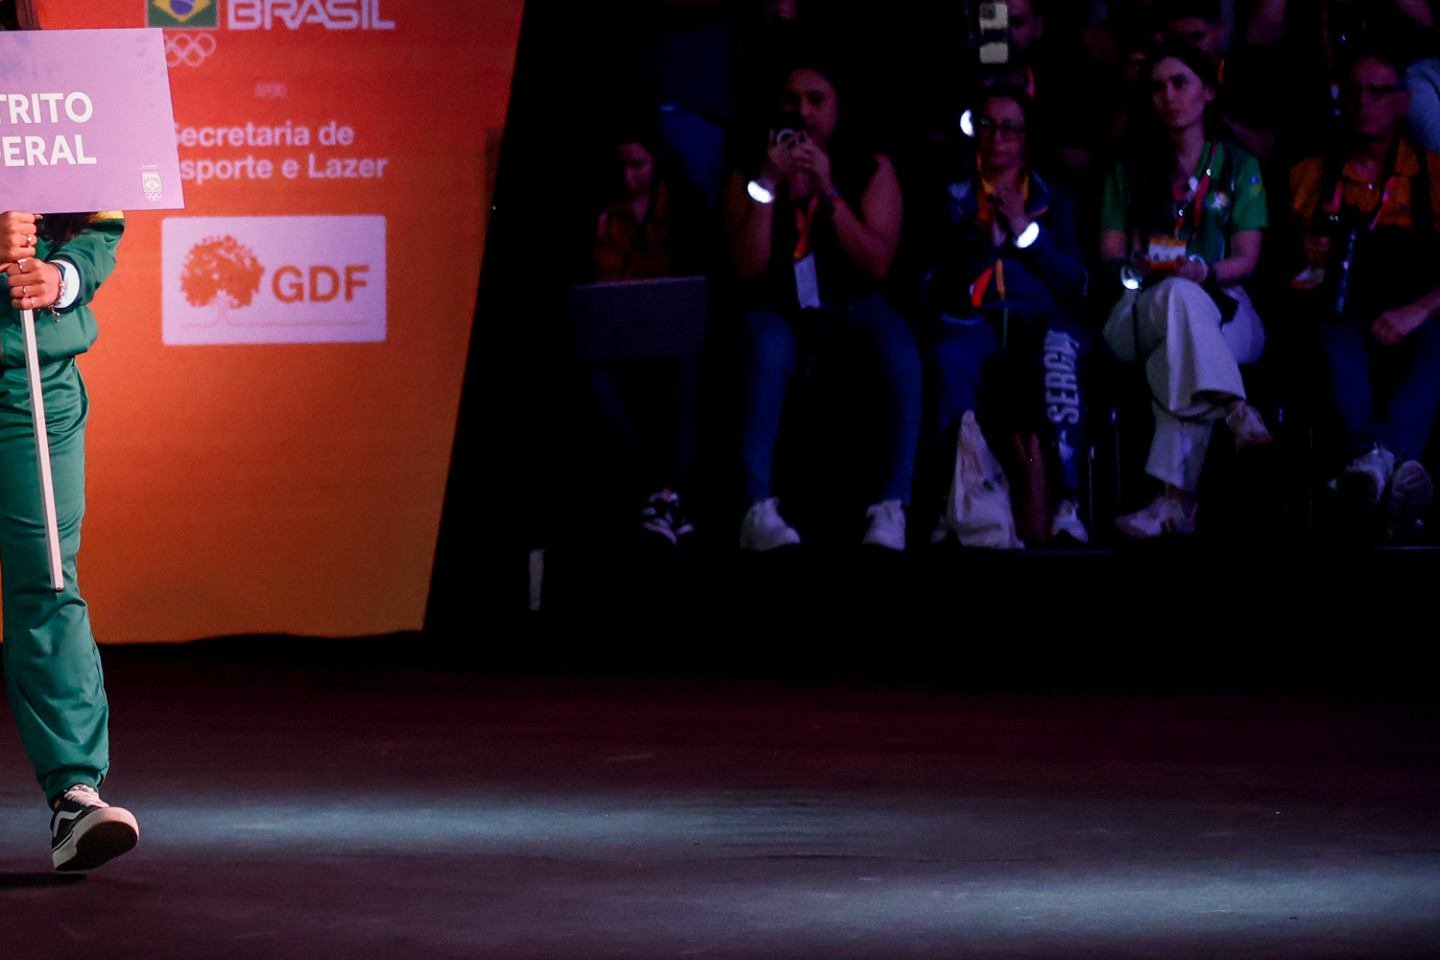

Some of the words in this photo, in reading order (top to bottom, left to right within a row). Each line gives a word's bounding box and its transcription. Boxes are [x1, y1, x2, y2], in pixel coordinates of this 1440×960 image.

[318, 120, 354, 147] de
[180, 154, 273, 185] sporte
[281, 158, 300, 179] e
[308, 152, 388, 179] Lazer
[272, 265, 370, 304] GDF
